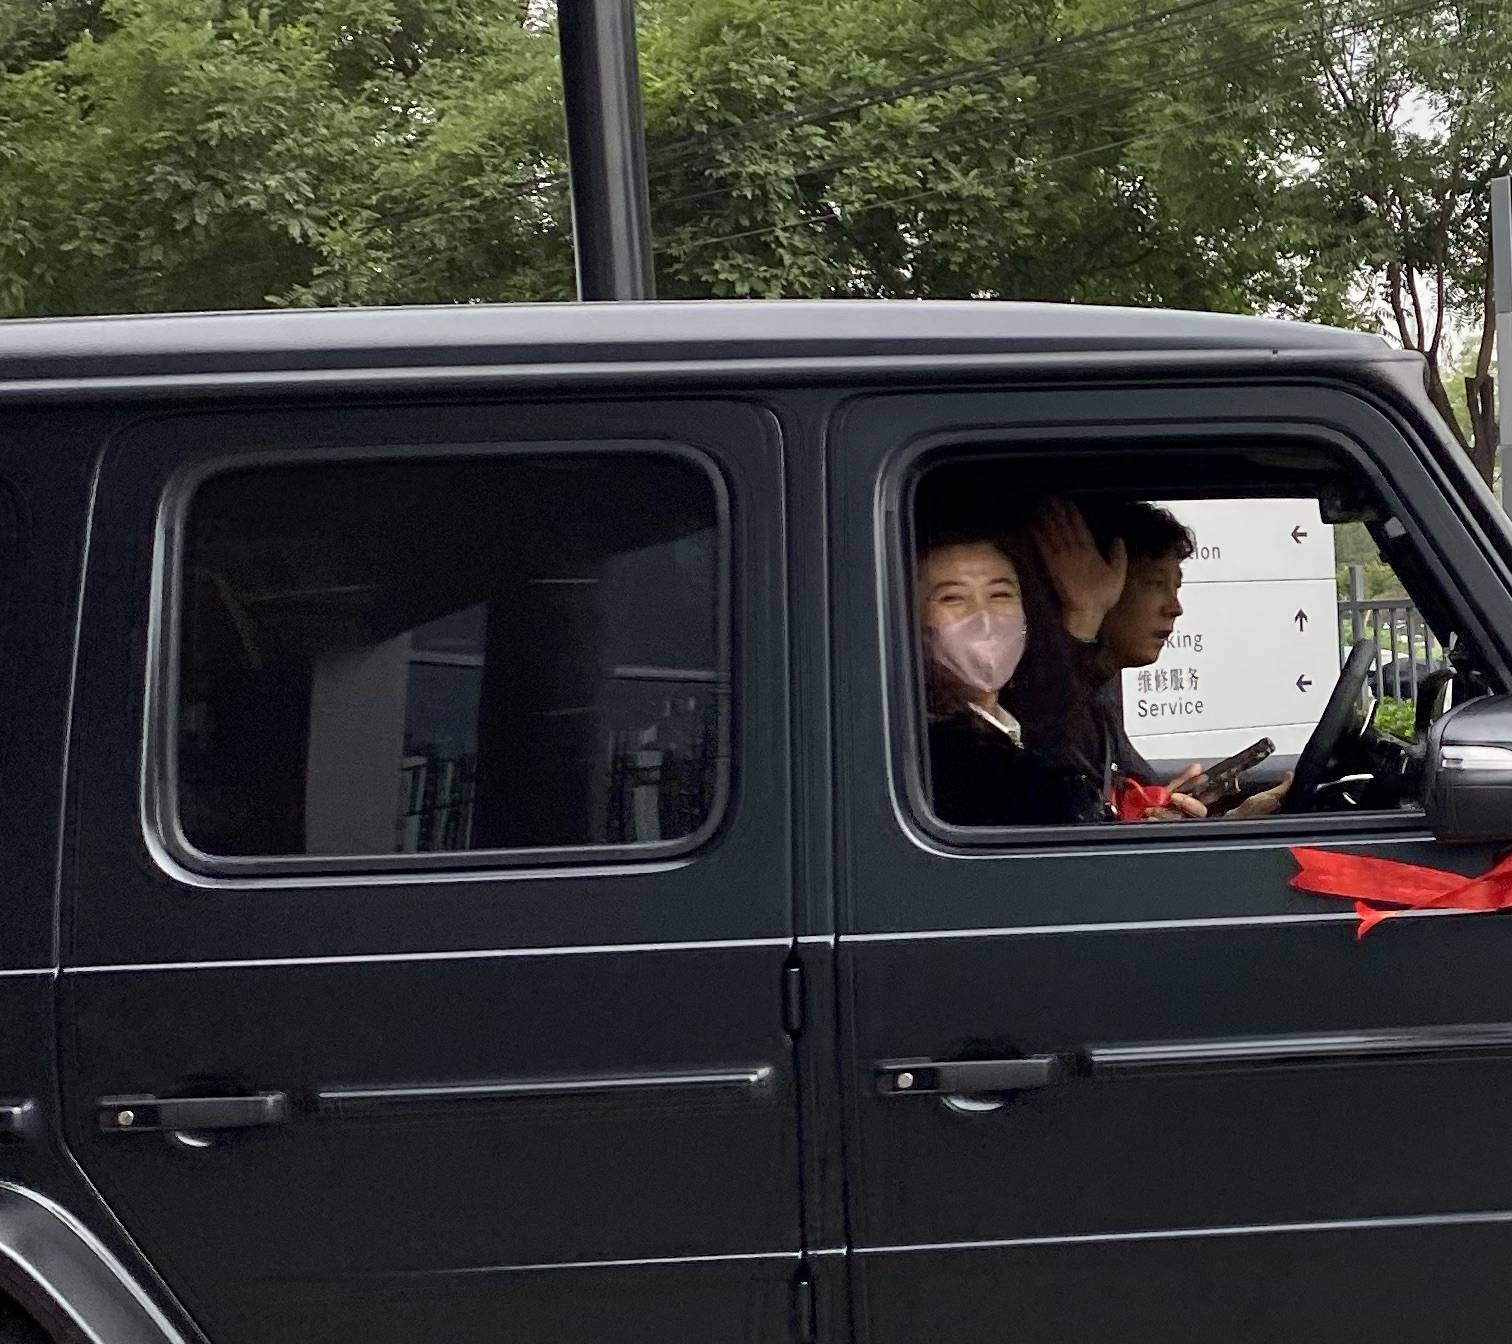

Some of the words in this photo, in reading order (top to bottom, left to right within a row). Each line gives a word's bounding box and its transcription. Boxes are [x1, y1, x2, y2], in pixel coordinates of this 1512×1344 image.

[1166, 630, 1204, 653] king
[1136, 667, 1200, 694] 维修服务
[1136, 698, 1204, 718] Service
